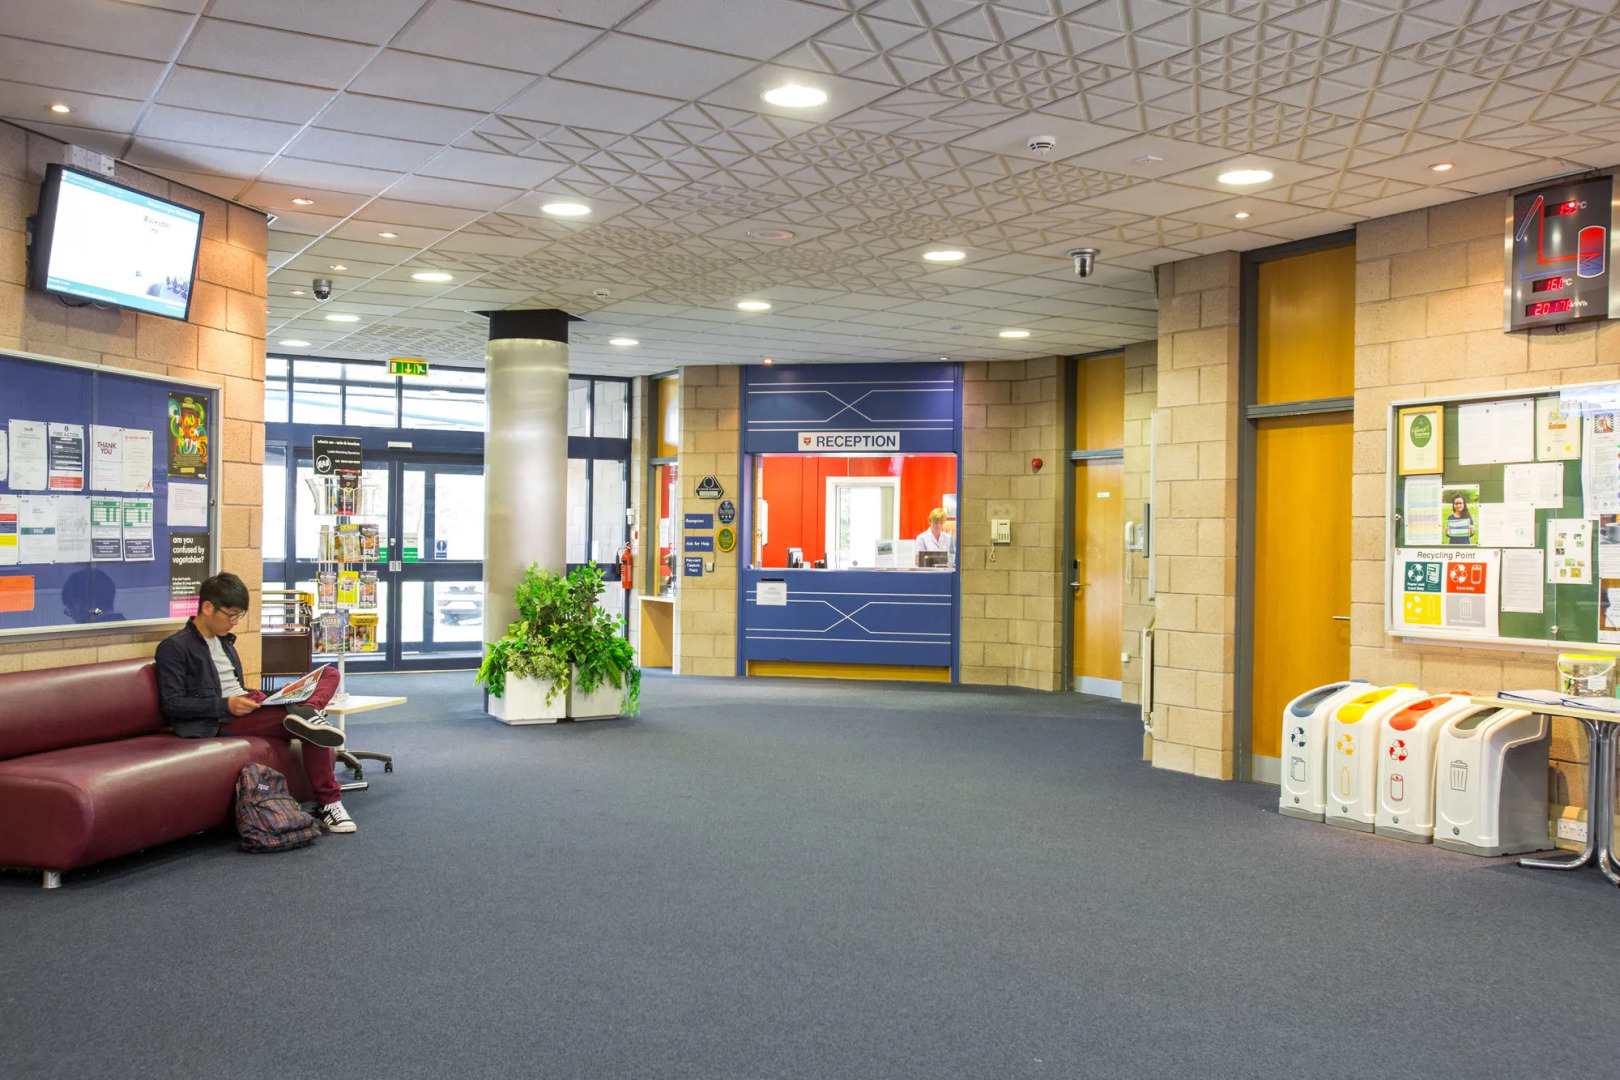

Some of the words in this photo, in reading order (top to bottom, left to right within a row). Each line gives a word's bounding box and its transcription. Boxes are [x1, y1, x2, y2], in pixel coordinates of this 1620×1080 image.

[97, 442, 116, 450] THANK
[816, 435, 896, 448] RECEPTION
[198, 546, 205, 555] by
[172, 556, 204, 565] vegetables?
[1417, 552, 1453, 560] Recycling
